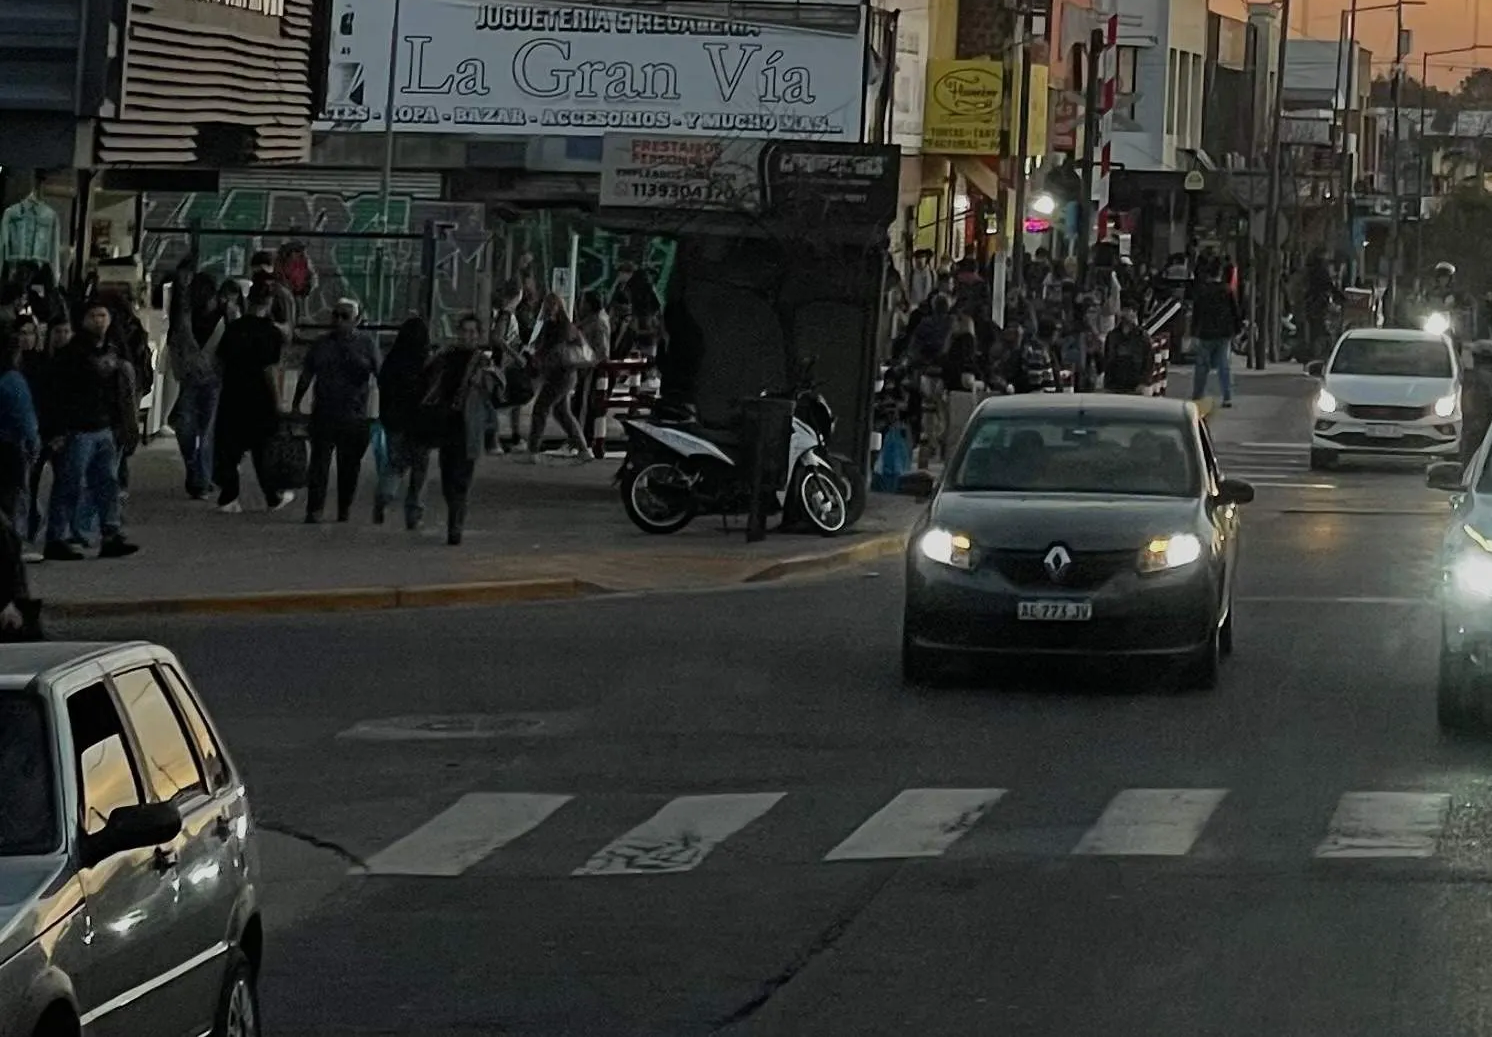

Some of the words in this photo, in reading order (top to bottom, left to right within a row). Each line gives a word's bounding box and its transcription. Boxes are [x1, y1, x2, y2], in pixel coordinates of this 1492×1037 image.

[475, 4, 611, 32] JUGUETERIA
[401, 35, 490, 96] La
[512, 38, 681, 101] Gran
[703, 43, 816, 104] Vía
[453, 106, 526, 126] BAZAR
[540, 107, 671, 129] ACCESORIOS
[682, 112, 700, 129] Y
[701, 112, 777, 132] MUCHO
